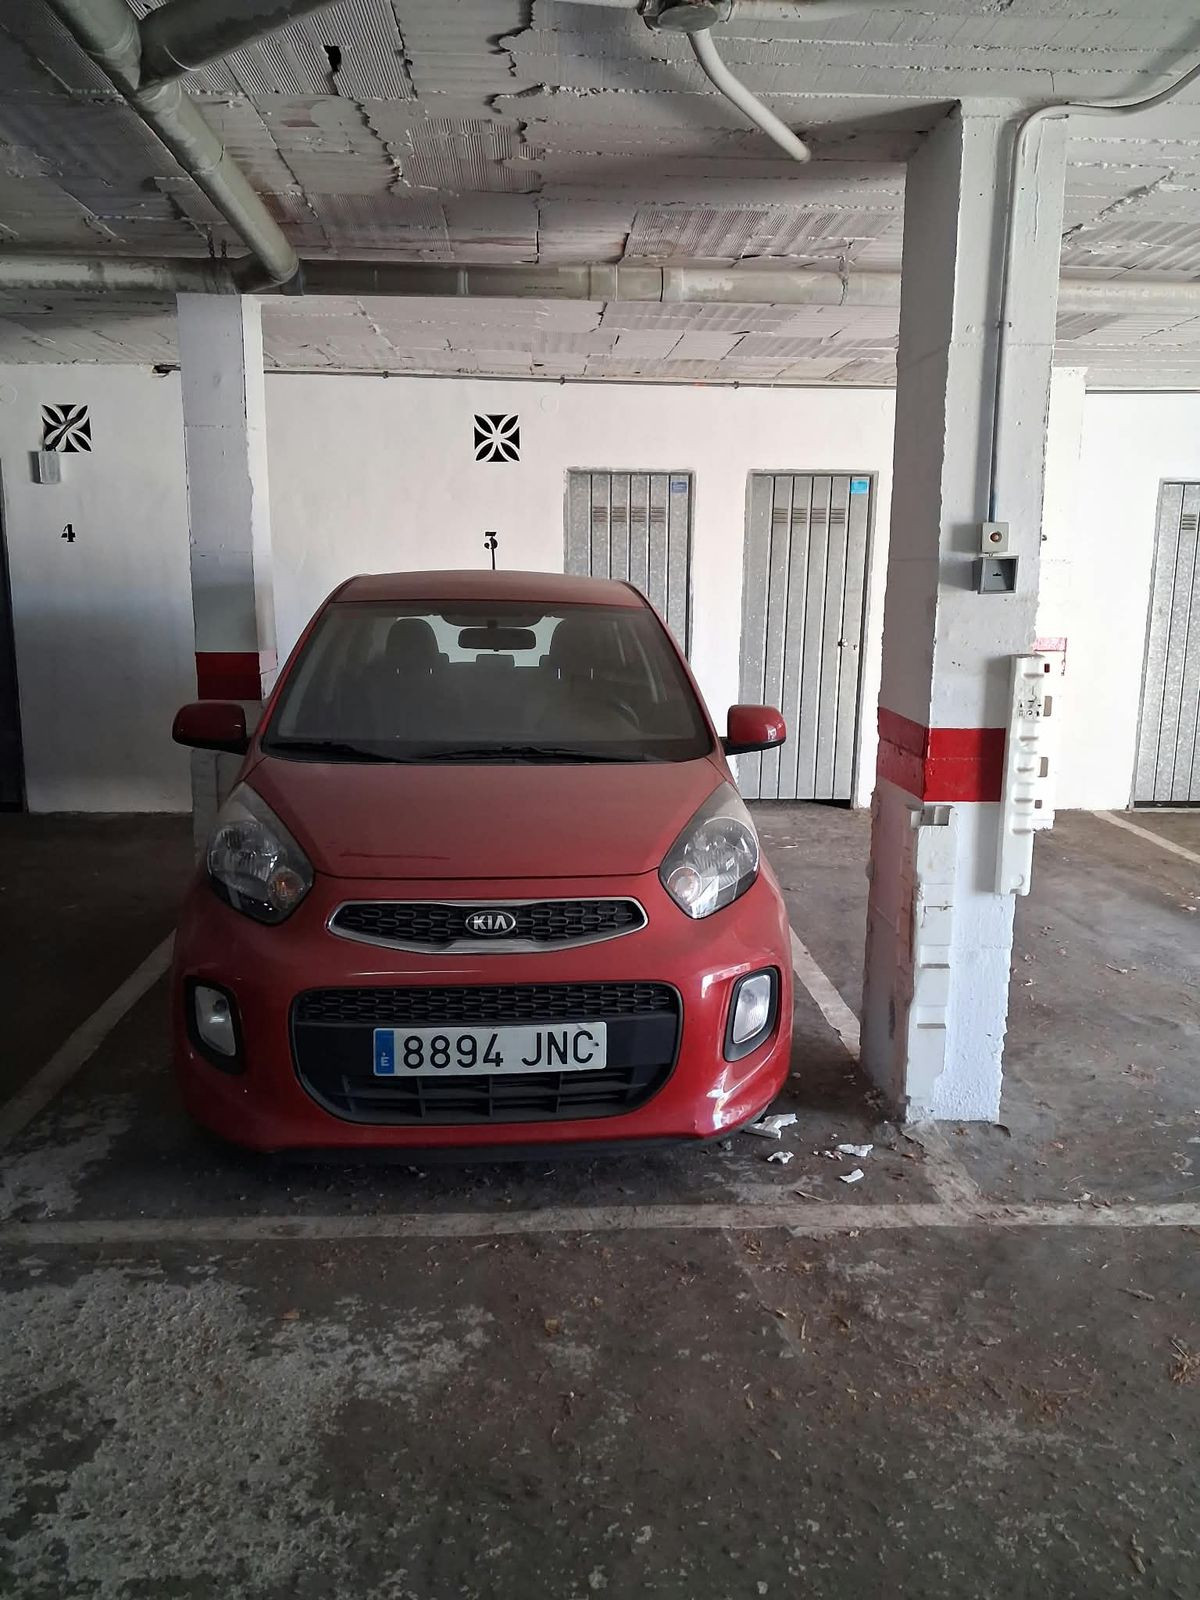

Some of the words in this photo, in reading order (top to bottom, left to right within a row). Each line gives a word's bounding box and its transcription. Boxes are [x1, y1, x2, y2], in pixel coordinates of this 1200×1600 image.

[61, 523, 76, 543] 4
[483, 531, 499, 550] 3
[473, 915, 508, 930] KIA
[403, 1033, 504, 1069] 8894
[521, 1030, 594, 1066] JNC
